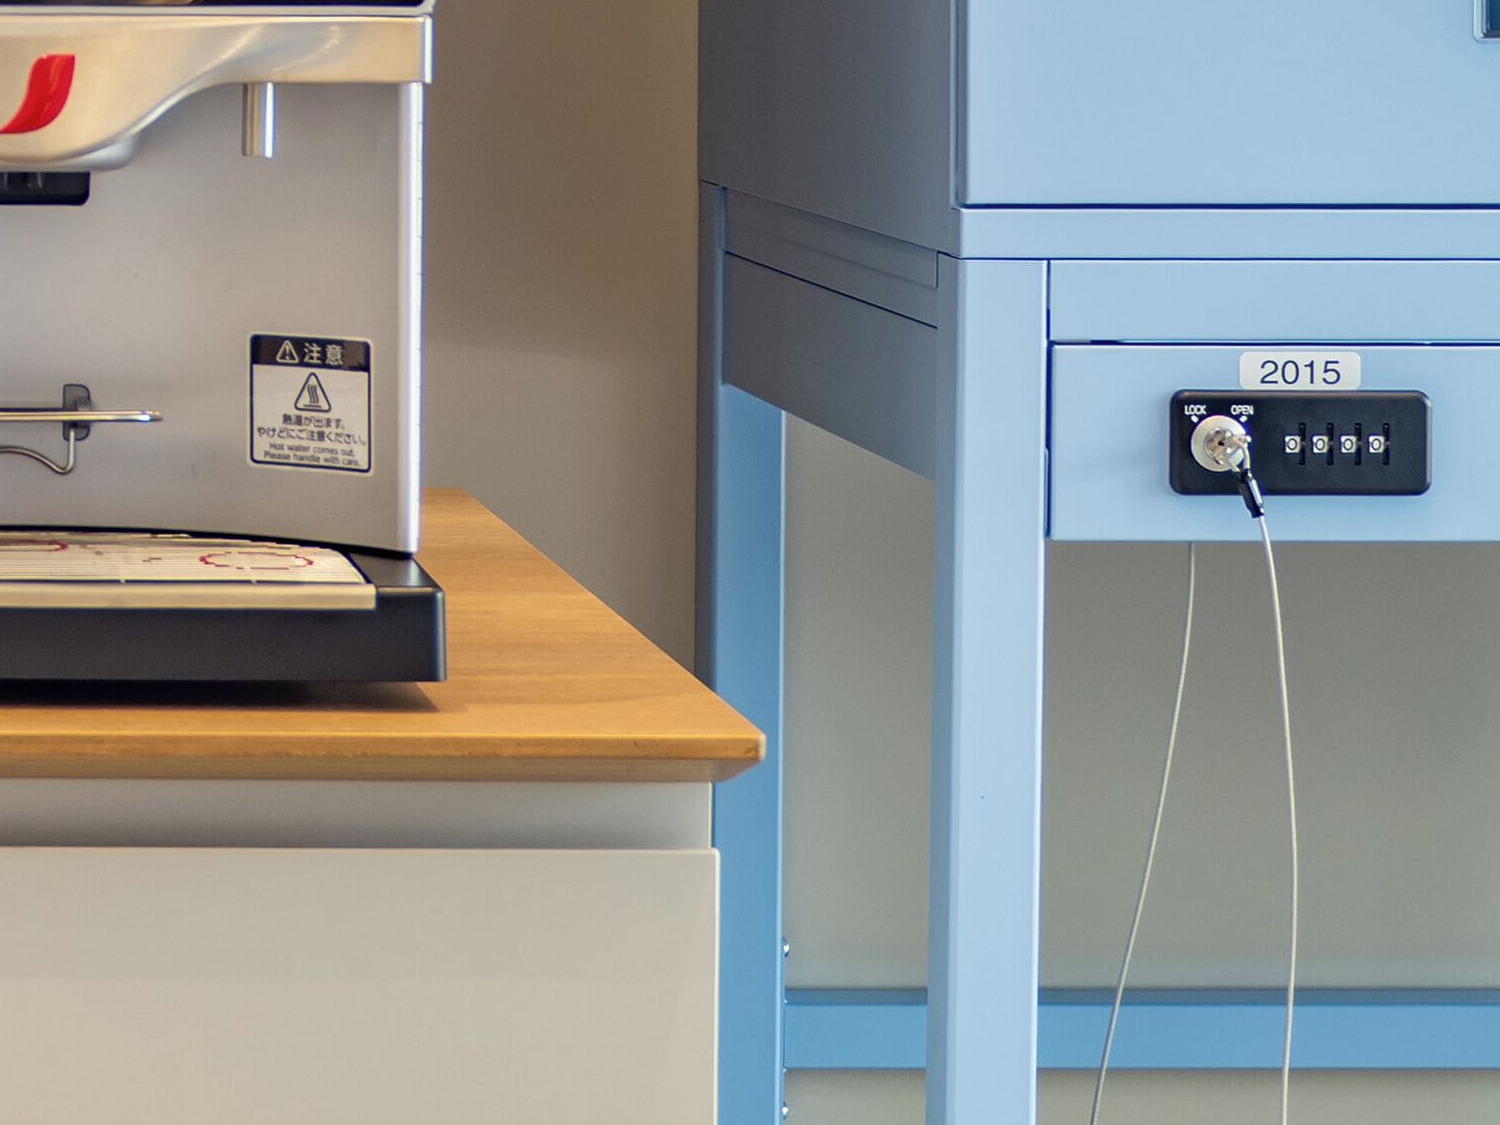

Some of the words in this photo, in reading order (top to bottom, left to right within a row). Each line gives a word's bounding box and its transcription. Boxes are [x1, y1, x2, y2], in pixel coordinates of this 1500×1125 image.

[303, 342, 344, 365] 注意
[1260, 360, 1342, 385] 2015
[1184, 405, 1207, 415] LOCK
[1230, 405, 1254, 415] OPEN
[269, 442, 284, 450] Hot
[287, 444, 310, 452] water
[312, 446, 338, 455] comes
[263, 451, 290, 460] Please
[293, 453, 321, 463] handle
[323, 455, 340, 464] with
